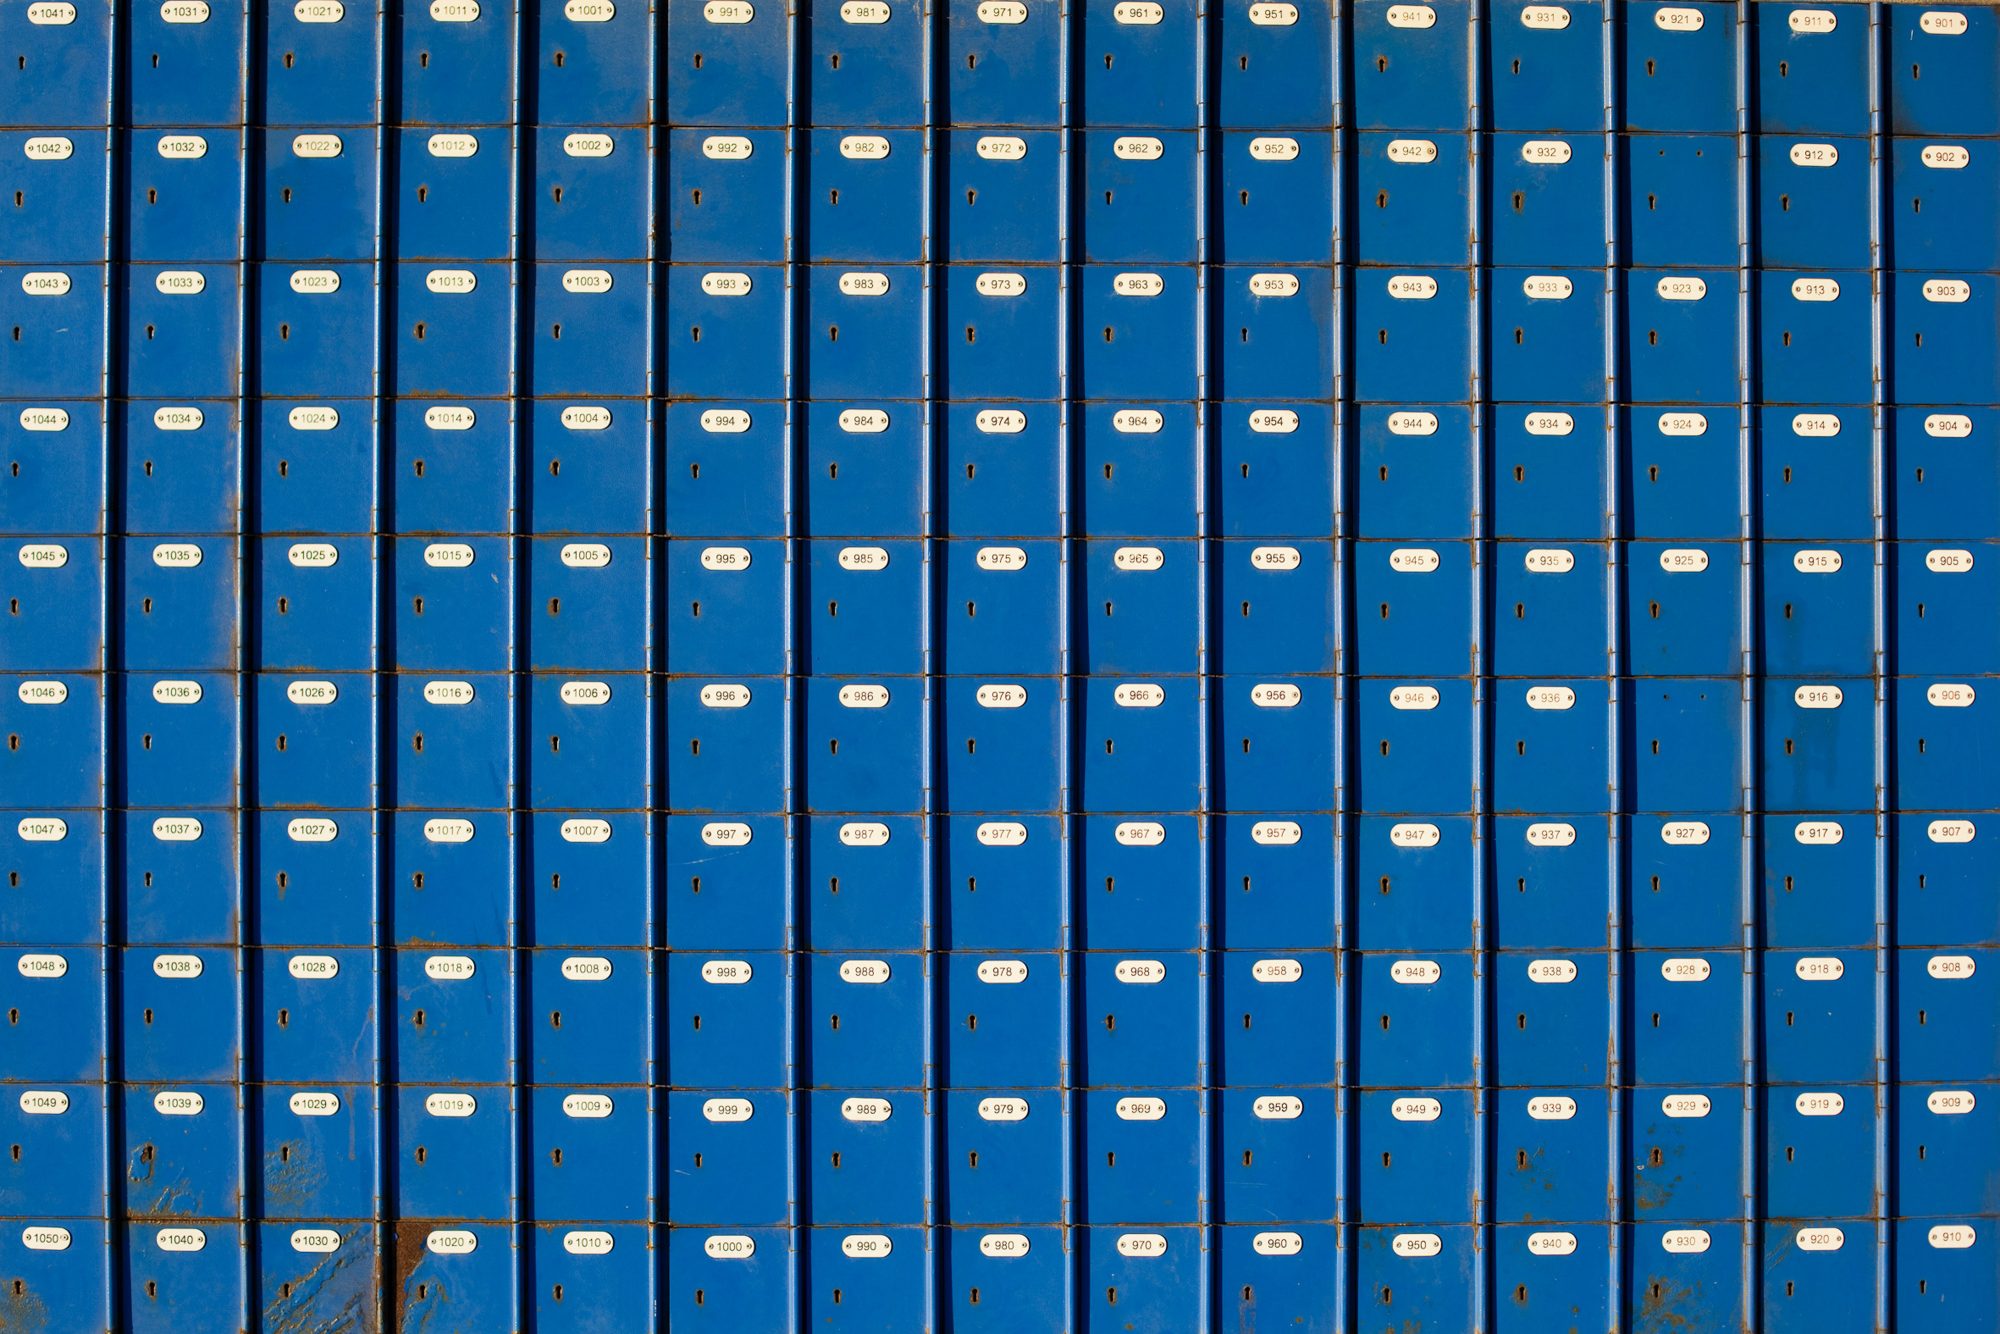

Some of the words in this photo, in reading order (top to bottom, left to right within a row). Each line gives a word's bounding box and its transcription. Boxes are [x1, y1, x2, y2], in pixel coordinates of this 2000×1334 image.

[40, 8, 64, 19] 1041
[173, 6, 197, 17] 1031
[307, 6, 331, 17] 1021
[444, 5, 467, 16] 1011
[578, 5, 602, 16] 1001
[719, 6, 738, 17] 991
[856, 7, 875, 17] 981
[992, 7, 1012, 17] 971
[1129, 7, 1148, 18] 961
[1264, 9, 1283, 19] 951
[1402, 11, 1421, 21] 941
[1536, 12, 1555, 22] 931
[1670, 14, 1689, 24] 921
[1804, 16, 1822, 26] 911
[1935, 17, 1953, 28] 901
[36, 143, 61, 154] 1042
[170, 141, 195, 152] 1032
[305, 141, 330, 151] 1022
[441, 140, 465, 151] 1012
[576, 140, 602, 151] 1002
[717, 142, 738, 153] 992
[854, 142, 875, 153] 982
[991, 143, 1012, 154] 972
[1128, 143, 1149, 154] 962
[1264, 143, 1284, 154] 952
[1402, 146, 1422, 156] 942
[1536, 147, 1557, 157] 932
[1804, 149, 1824, 160] 912
[1935, 151, 1955, 162] 902
[33, 278, 59, 289] 1043
[168, 277, 193, 288] 1033
[302, 276, 328, 287] 1023
[438, 276, 464, 287] 1013
[574, 276, 600, 287] 1003
[716, 278, 737, 290] 993
[853, 278, 874, 289] 983
[990, 279, 1011, 290] 973
[1128, 279, 1149, 290] 963
[1264, 279, 1284, 290] 953
[1402, 282, 1423, 293] 943
[1538, 282, 1558, 293] 933
[1672, 283, 1692, 294] 923
[1805, 284, 1825, 296] 913
[1936, 285, 1956, 296] 903
[32, 414, 57, 425] 1044
[166, 413, 191, 424] 1034
[301, 413, 326, 424] 1024
[437, 413, 463, 423] 1014
[573, 413, 599, 424] 1004
[715, 415, 736, 427] 994
[853, 415, 874, 426] 984
[990, 416, 1011, 427] 974
[1127, 416, 1148, 427] 964
[1263, 415, 1284, 427] 954
[1402, 418, 1423, 429] 944
[1539, 418, 1559, 429] 934
[1672, 419, 1692, 430] 924
[1806, 420, 1826, 431] 914
[1938, 420, 1958, 432] 904
[30, 550, 56, 561] 1045
[164, 550, 190, 561] 1035
[300, 550, 326, 561] 1025
[436, 550, 462, 561] 1015
[573, 550, 599, 561] 1005
[715, 553, 736, 565] 995
[853, 553, 874, 564] 985
[991, 553, 1012, 564] 975
[1128, 553, 1149, 564] 965
[1265, 552, 1286, 564] 955
[1404, 555, 1425, 566] 945
[1539, 555, 1559, 566] 935
[1674, 555, 1694, 566] 925
[1939, 555, 1960, 566] 905
[1807, 556, 1828, 567] 915
[30, 687, 56, 698] 1046
[164, 687, 190, 698] 1036
[299, 687, 325, 698] 1026
[436, 687, 462, 698] 1016
[572, 687, 599, 699] 1006
[715, 690, 736, 701] 996
[853, 691, 874, 702] 986
[991, 690, 1012, 702] 976
[1129, 689, 1150, 701] 966
[1265, 690, 1286, 701] 956
[1404, 693, 1425, 703] 946
[1540, 692, 1561, 703] 936
[1808, 691, 1829, 702] 916
[1941, 690, 1961, 701] 906
[29, 824, 55, 835] 1047
[164, 823, 190, 835] 1037
[299, 824, 326, 835] 1027
[436, 825, 462, 836] 1017
[573, 825, 599, 836] 1007
[716, 828, 737, 840] 997
[854, 829, 875, 840] 987
[991, 828, 1012, 839] 977
[1129, 828, 1150, 839] 967
[1266, 827, 1287, 838] 957
[1541, 829, 1561, 840] 937
[1675, 828, 1696, 839] 927
[1808, 827, 1829, 839] 917
[1941, 826, 1961, 837] 907
[1405, 830, 1425, 841] 947
[30, 960, 56, 972] 1048
[165, 961, 191, 972] 1038
[301, 961, 327, 973] 1028
[437, 962, 463, 973] 1018
[574, 963, 600, 974] 1008
[854, 966, 875, 977] 988
[992, 966, 1013, 977] 978
[1130, 966, 1151, 977] 968
[1267, 965, 1288, 976] 958
[1542, 966, 1562, 977] 938
[1676, 964, 1696, 975] 928
[1809, 963, 1829, 974] 918
[1941, 962, 1961, 973] 908
[716, 967, 737, 978] 998
[1405, 967, 1426, 977] 948
[31, 1097, 57, 1108] 1049
[166, 1098, 192, 1109] 1039
[301, 1098, 328, 1110] 1029
[439, 1100, 464, 1111] 1019
[575, 1101, 601, 1112] 1009
[1267, 1102, 1289, 1113] 959
[1542, 1102, 1562, 1113] 939
[1676, 1101, 1697, 1111] 929
[1810, 1098, 1830, 1109] 919
[1941, 1097, 1961, 1108] 909
[717, 1104, 738, 1115] 999
[856, 1104, 877, 1115] 989
[993, 1103, 1014, 1115] 979
[1130, 1103, 1151, 1114] 969
[1406, 1104, 1427, 1115] 949
[33, 1233, 60, 1244] 1050
[168, 1234, 194, 1245] 1040
[302, 1235, 329, 1246] 1030
[439, 1236, 465, 1247] 1020
[1676, 1236, 1696, 1246] 930
[1810, 1234, 1830, 1245] 920
[1942, 1231, 1962, 1242] 910
[575, 1237, 602, 1248] 1010
[716, 1241, 743, 1252] 1000
[856, 1240, 877, 1252] 990
[994, 1240, 1015, 1251] 980
[1131, 1240, 1152, 1251] 970
[1267, 1238, 1288, 1249] 960
[1407, 1239, 1427, 1251] 950
[1542, 1238, 1562, 1249] 940
